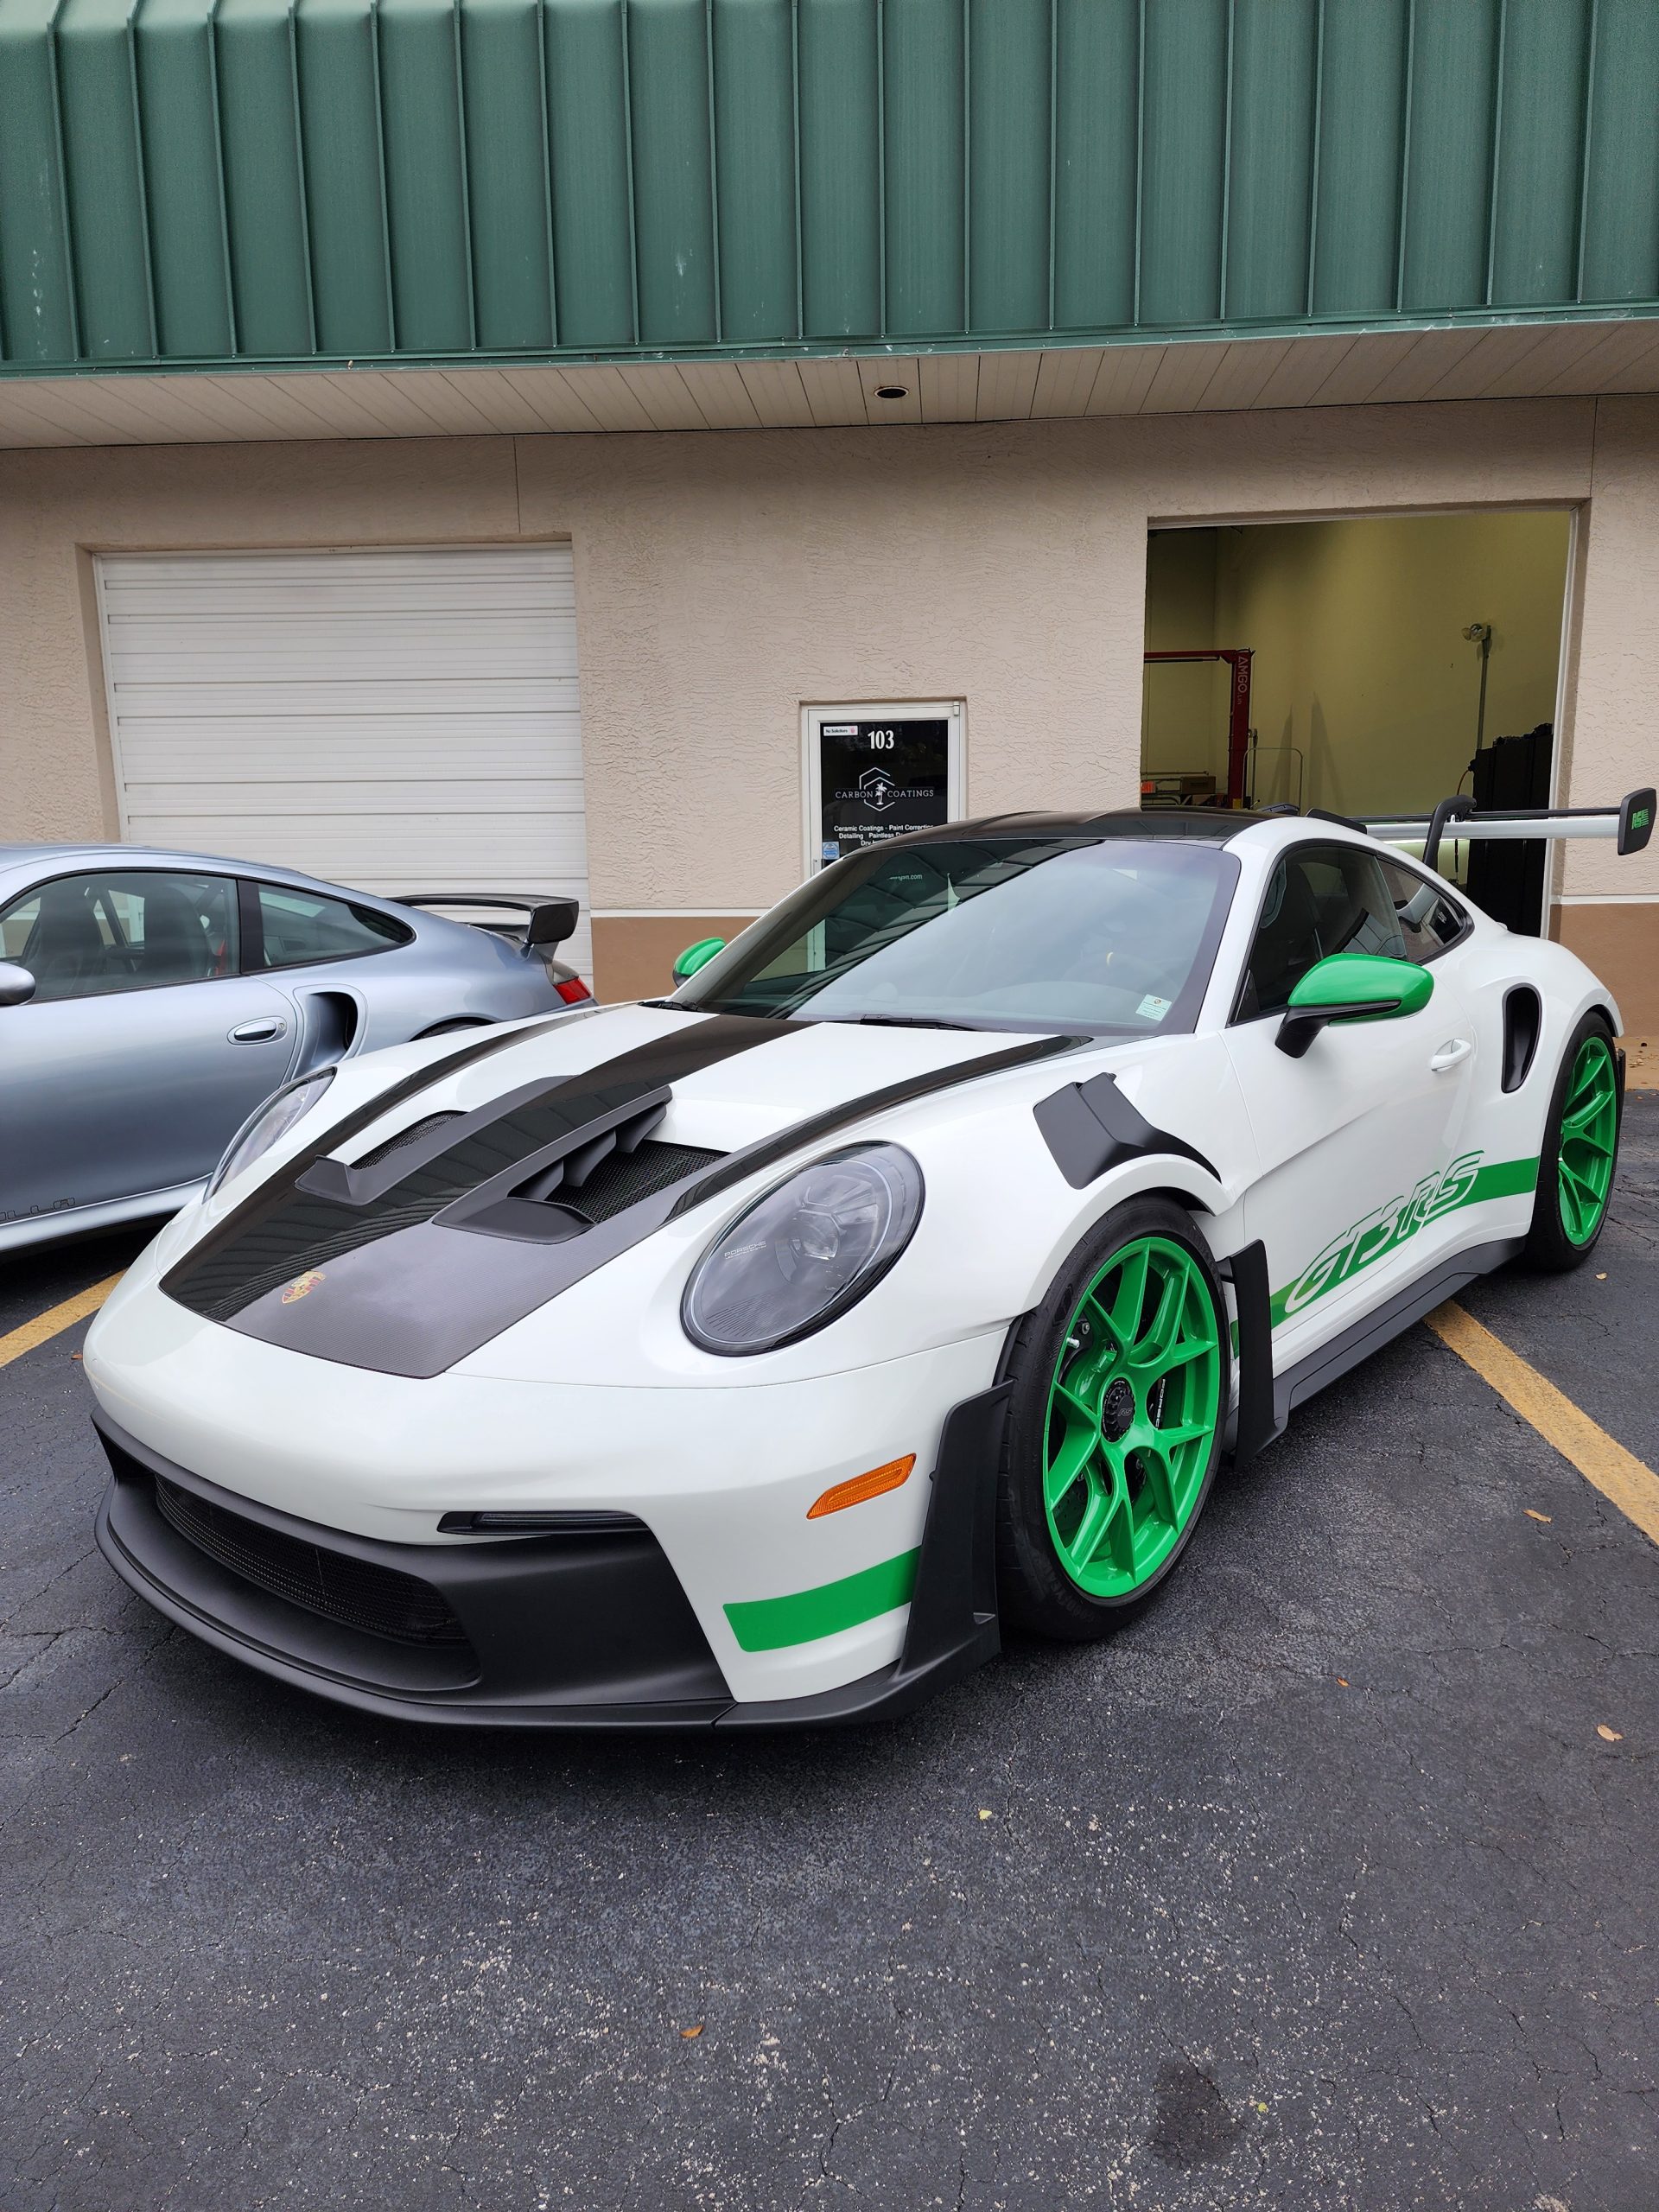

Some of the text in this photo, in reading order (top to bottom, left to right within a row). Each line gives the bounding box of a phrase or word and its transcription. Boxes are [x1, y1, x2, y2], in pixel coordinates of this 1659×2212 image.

[1238, 657, 1248, 693] AMGO
[868, 730, 894, 749] 103
[724, 1240, 766, 1257] PORSCHE
[1155, 1378, 1166, 1428] PORSC
